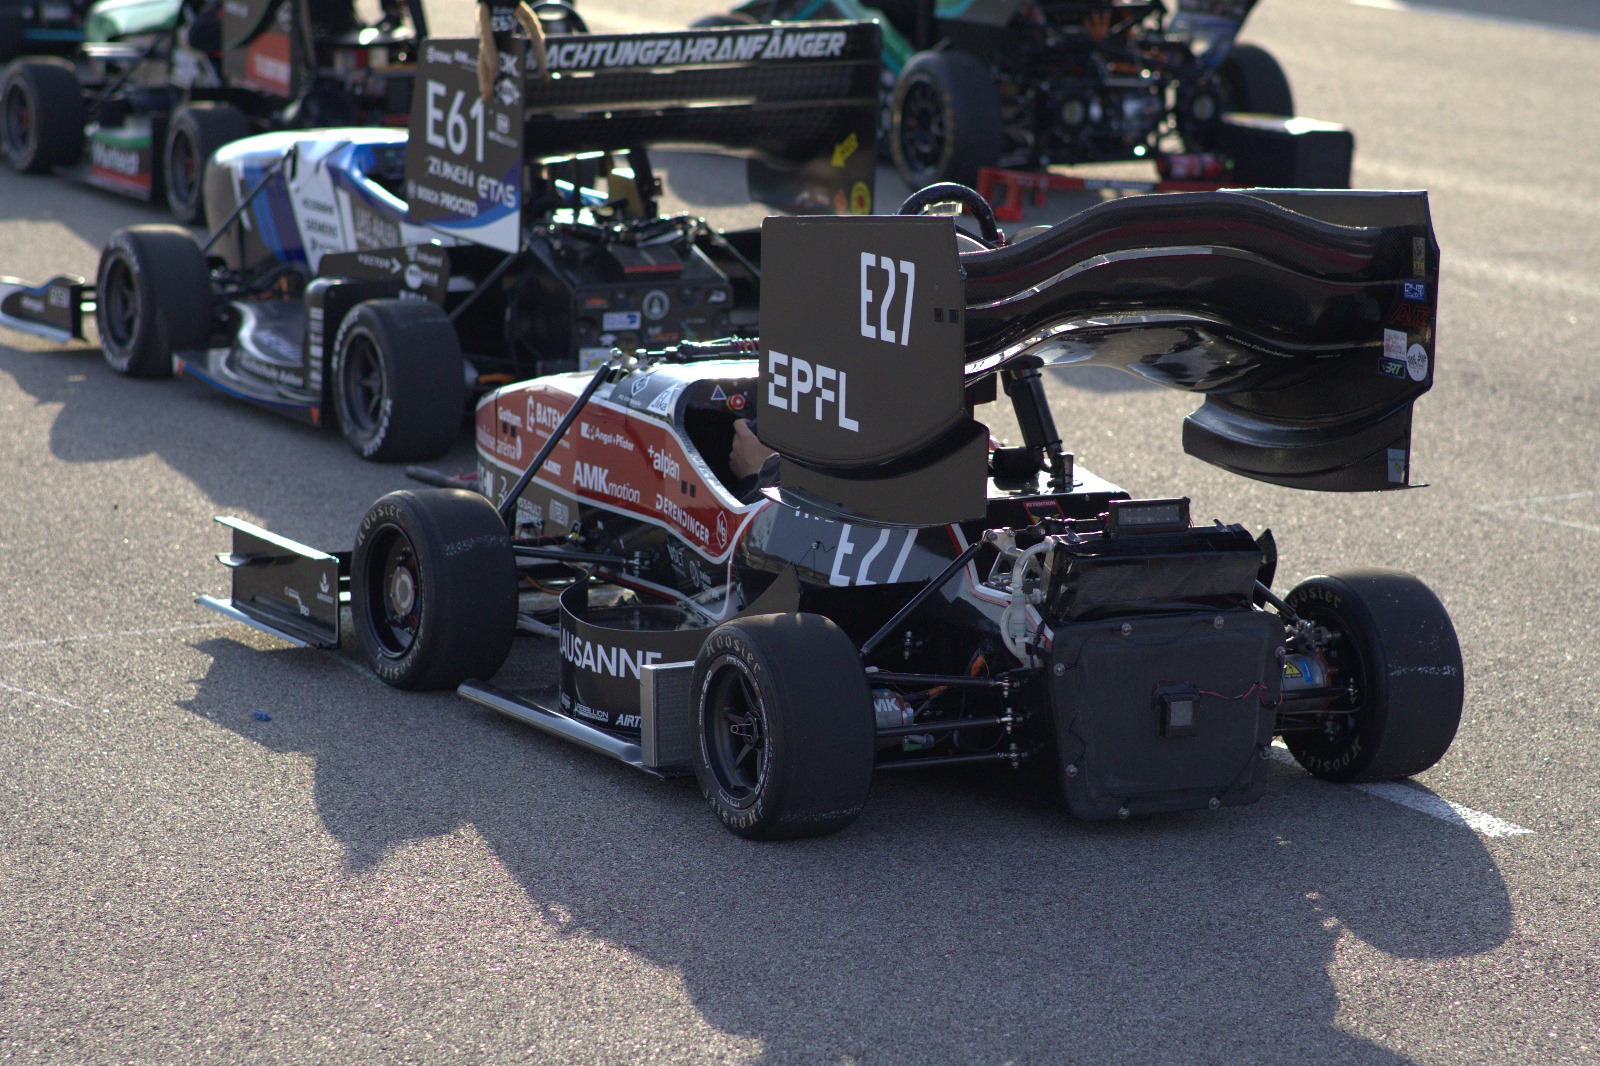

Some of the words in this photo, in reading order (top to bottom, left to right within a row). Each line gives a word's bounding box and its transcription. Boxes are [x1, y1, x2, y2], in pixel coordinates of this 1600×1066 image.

[426, 80, 484, 163] E61
[860, 251, 916, 347] E27
[536, 402, 571, 436] BATE
[768, 349, 859, 433] EPFL
[655, 492, 710, 546] DERENDINGER
[615, 713, 642, 729] AIRT
